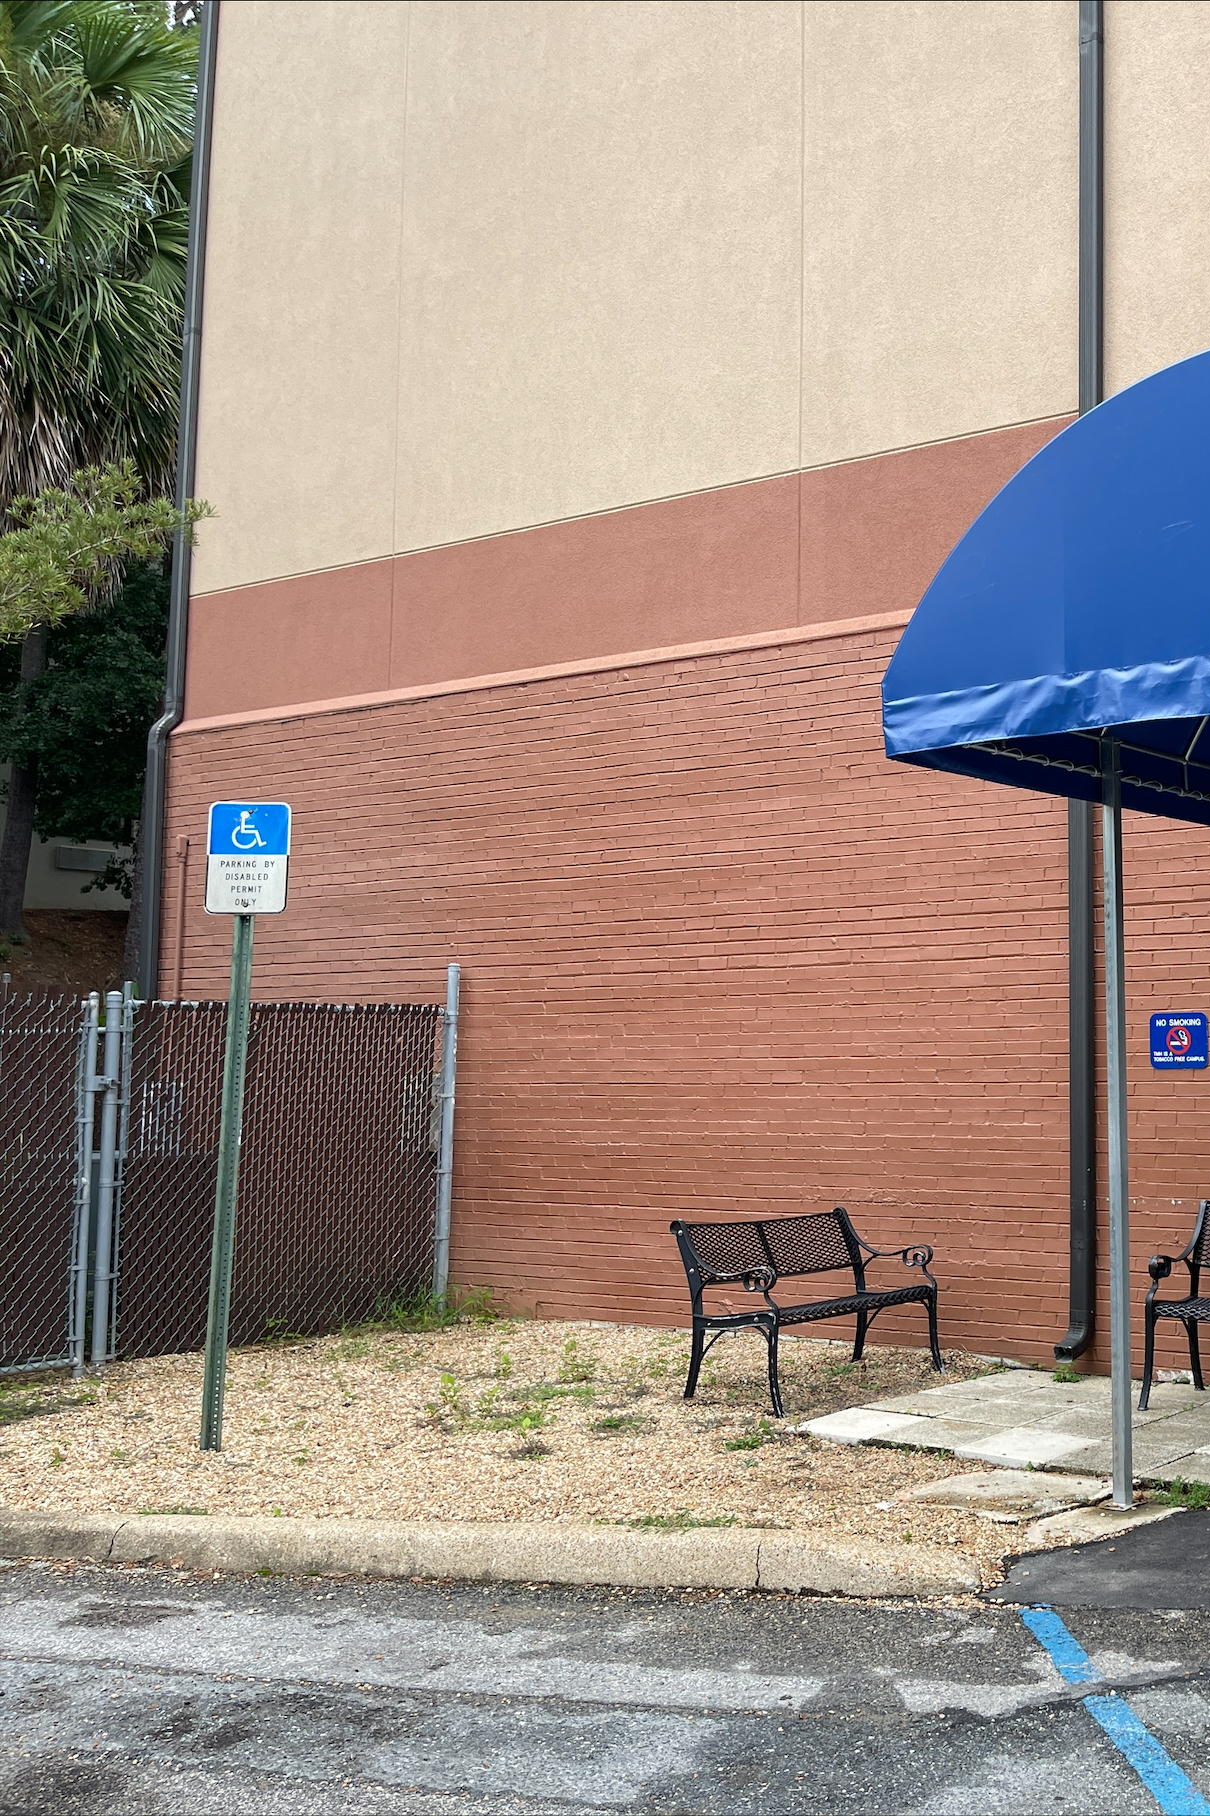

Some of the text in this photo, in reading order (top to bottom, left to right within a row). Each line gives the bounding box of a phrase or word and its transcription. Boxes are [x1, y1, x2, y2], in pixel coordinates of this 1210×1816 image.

[220, 860, 276, 868] PARKING BY
[225, 873, 269, 881] DISABLED
[230, 885, 262, 893] PERMIT
[234, 898, 257, 906] ONLY
[1155, 1018, 1202, 1027] NO SMOKING
